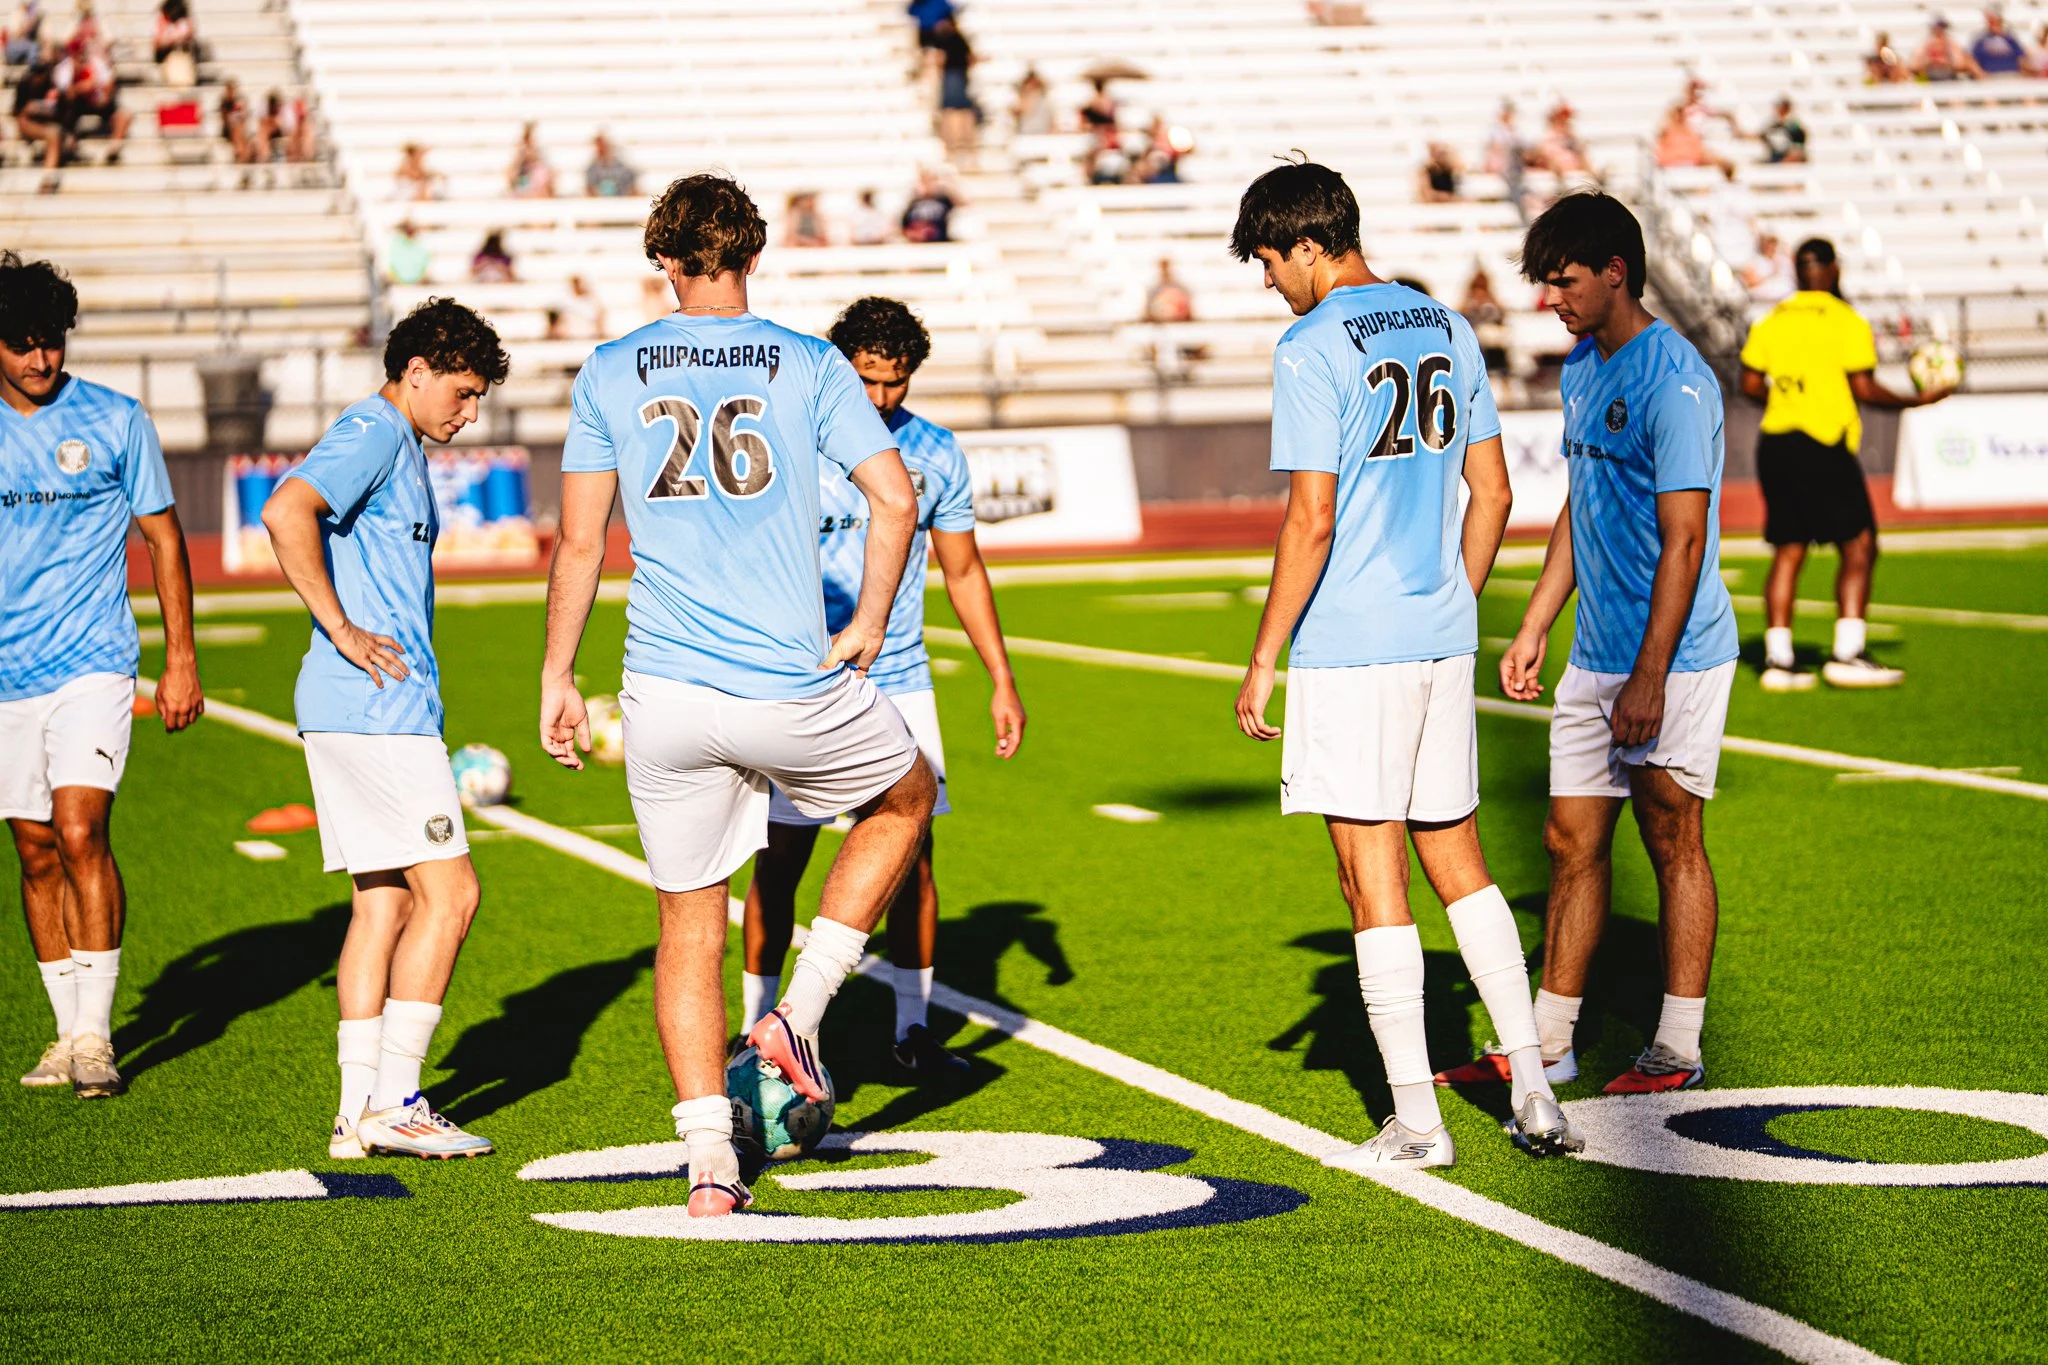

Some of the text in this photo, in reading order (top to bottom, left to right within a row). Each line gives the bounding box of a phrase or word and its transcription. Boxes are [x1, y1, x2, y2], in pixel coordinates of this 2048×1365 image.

[636, 344, 781, 387] CHUPACABRAS
[1343, 307, 1453, 355] CHUPACABRAS
[1364, 353, 1457, 460] 26
[637, 395, 777, 502] 26
